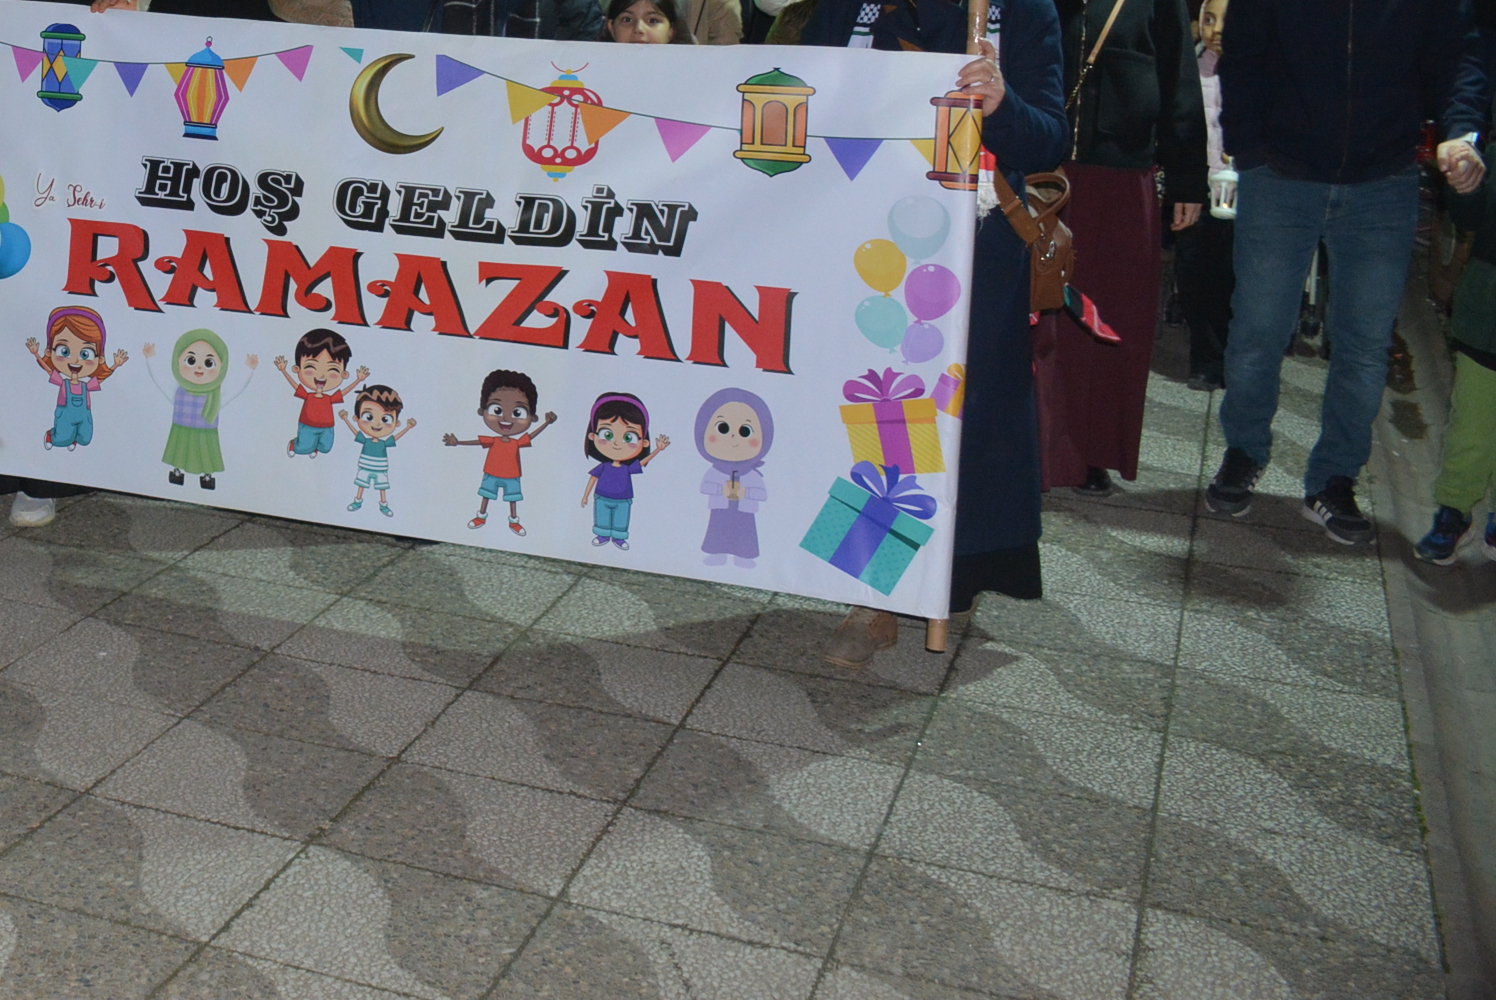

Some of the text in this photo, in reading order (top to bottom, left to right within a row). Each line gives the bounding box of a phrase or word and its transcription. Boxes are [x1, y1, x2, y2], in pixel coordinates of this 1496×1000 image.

[33, 172, 57, 208] Ya
[135, 155, 699, 258] HOŞ GELDİN
[61, 217, 799, 376] RAMAZAN
